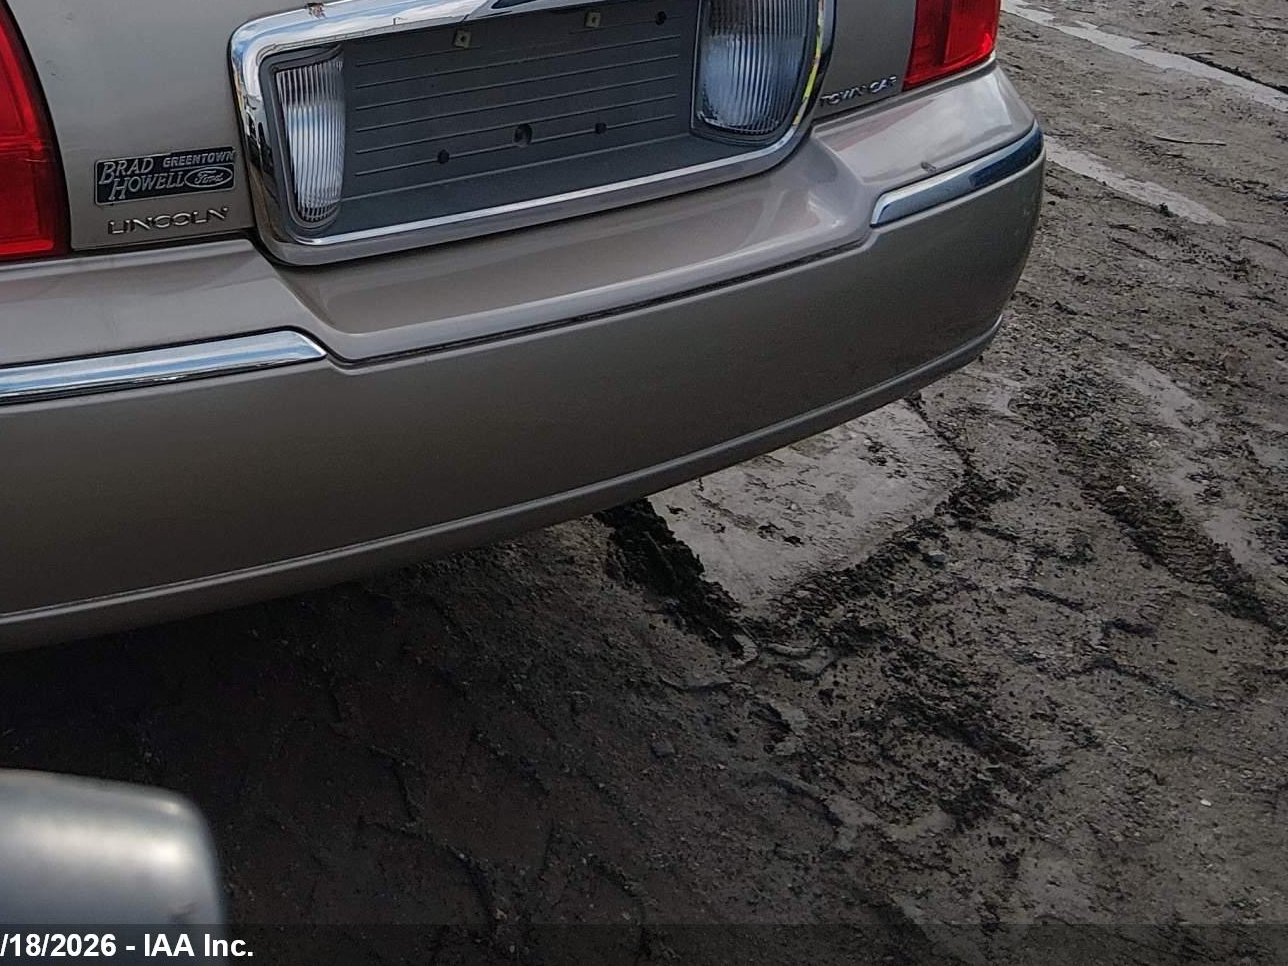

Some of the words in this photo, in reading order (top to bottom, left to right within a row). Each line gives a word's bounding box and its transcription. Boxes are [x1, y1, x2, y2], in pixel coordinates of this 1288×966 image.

[99, 157, 154, 184] BRAD
[163, 151, 233, 168] GREENTOWN
[108, 171, 184, 200] HOWELL
[194, 170, 224, 185] Ford
[108, 207, 228, 235] LINCOLN
